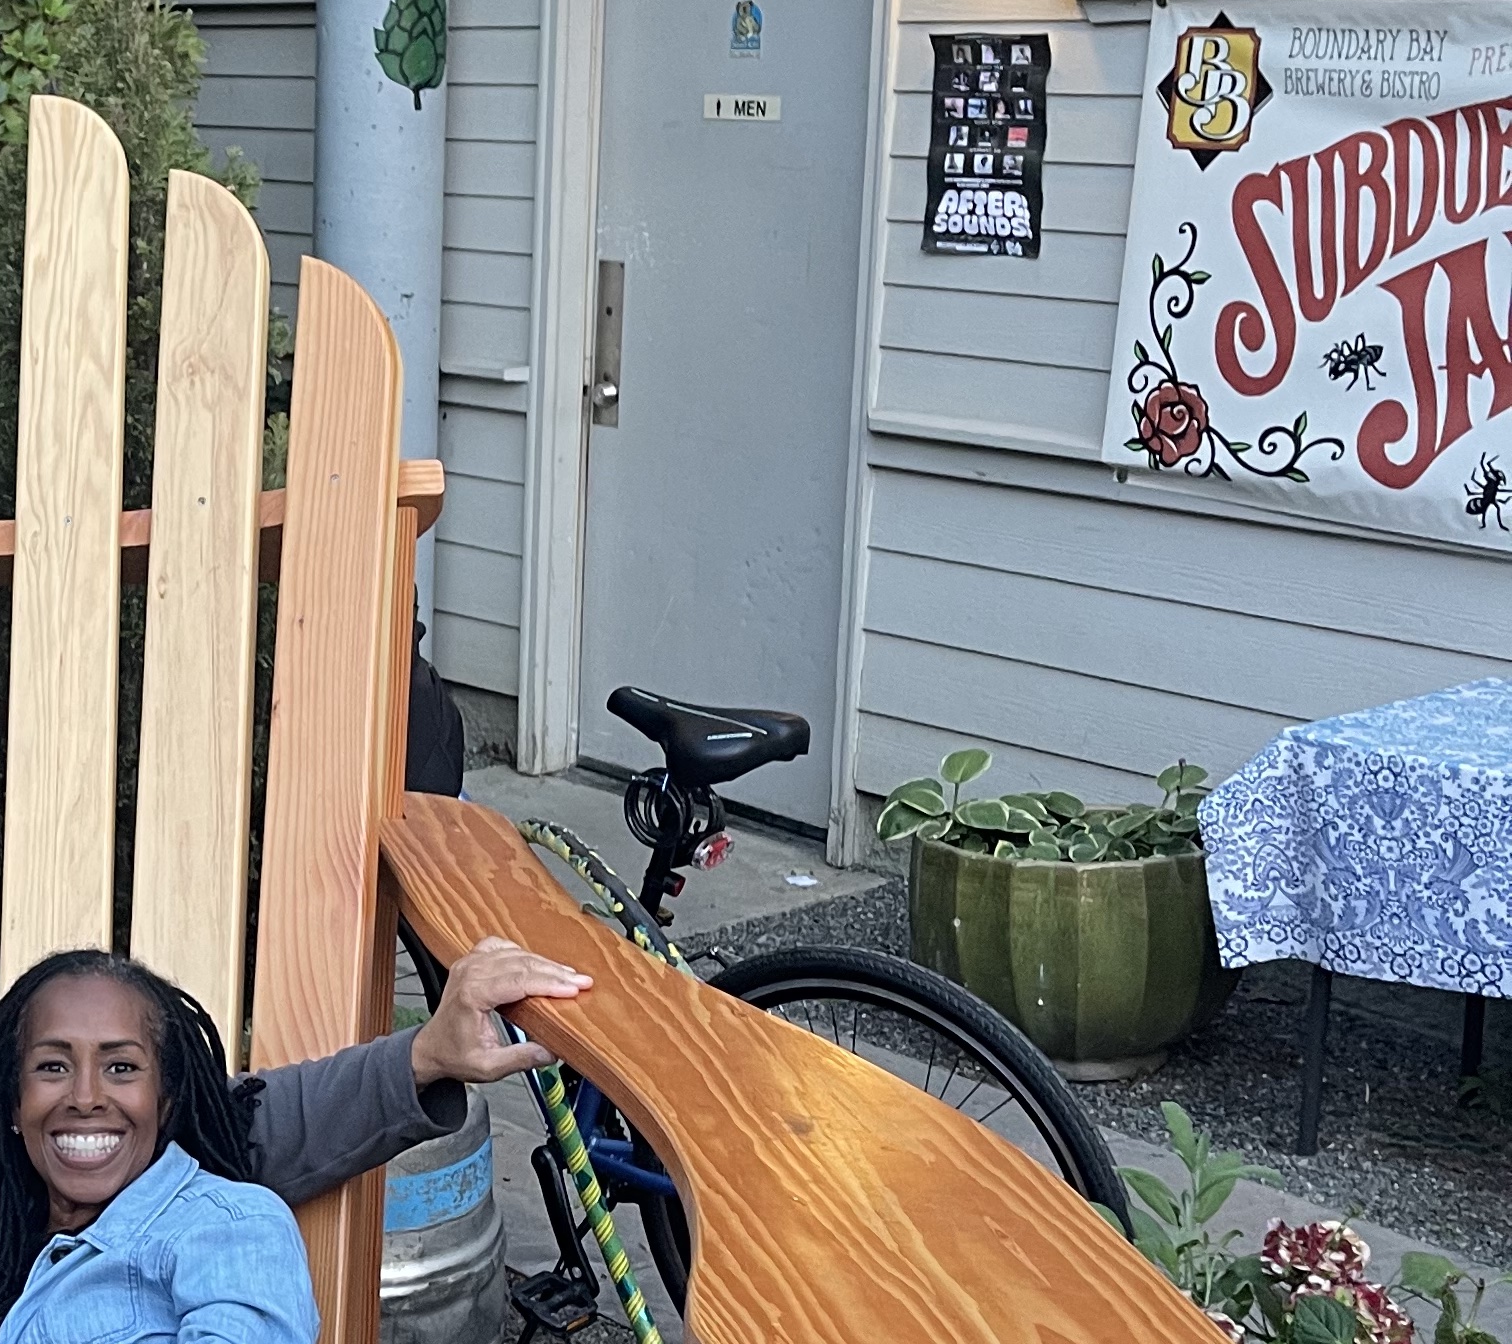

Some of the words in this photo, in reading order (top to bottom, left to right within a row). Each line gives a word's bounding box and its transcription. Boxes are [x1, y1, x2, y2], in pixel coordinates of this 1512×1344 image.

[1288, 27, 1401, 63] BOUNDARY
[1406, 29, 1448, 62] BAY
[1468, 42, 1512, 76] PRE
[1379, 70, 1441, 101] BISTRO
[734, 99, 767, 118] MEN
[937, 189, 1028, 218] AFTER
[932, 212, 1031, 239] SOUNDS
[1357, 231, 1512, 489] JA
